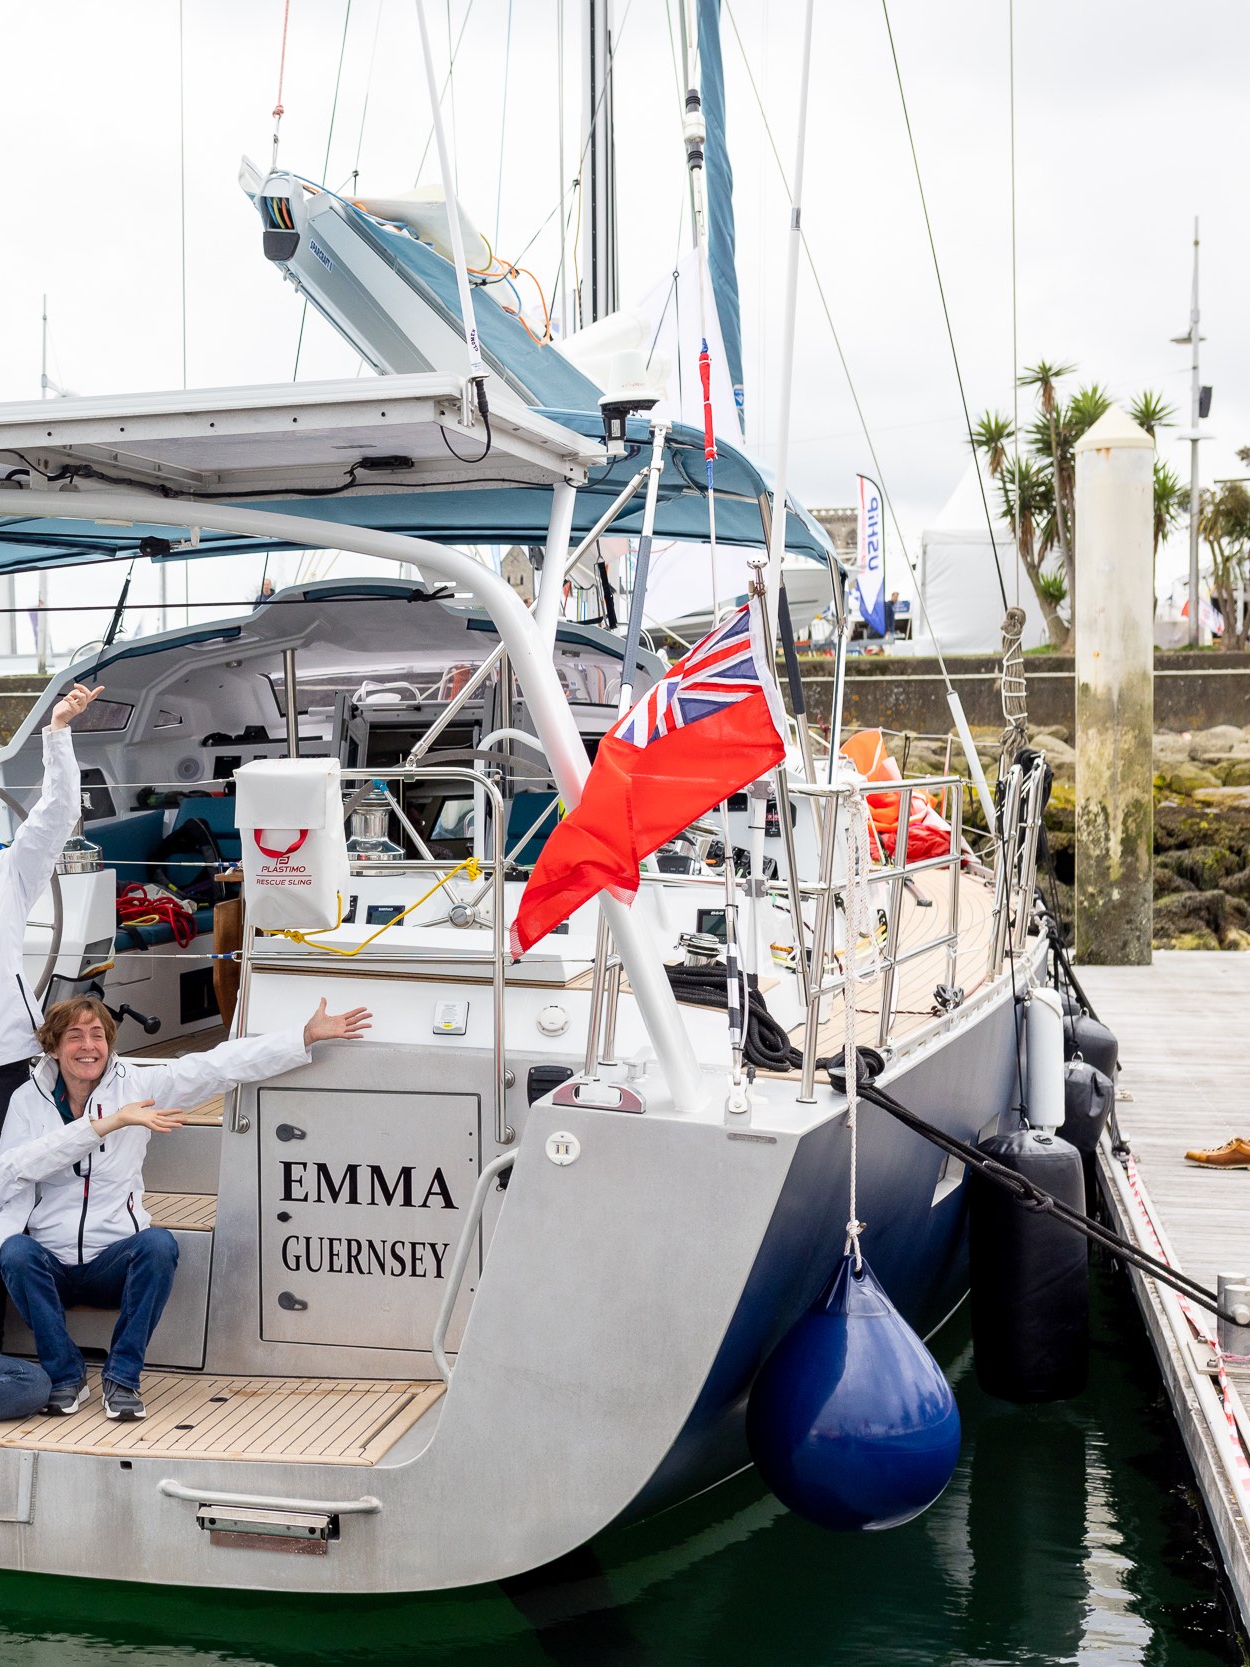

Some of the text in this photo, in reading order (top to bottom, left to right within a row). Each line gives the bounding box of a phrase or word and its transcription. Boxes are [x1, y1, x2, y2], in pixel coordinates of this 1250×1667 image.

[261, 865, 306, 873] PLASTIMO
[279, 1160, 459, 1209] EMMA
[281, 1235, 450, 1279] GUERNSEY
